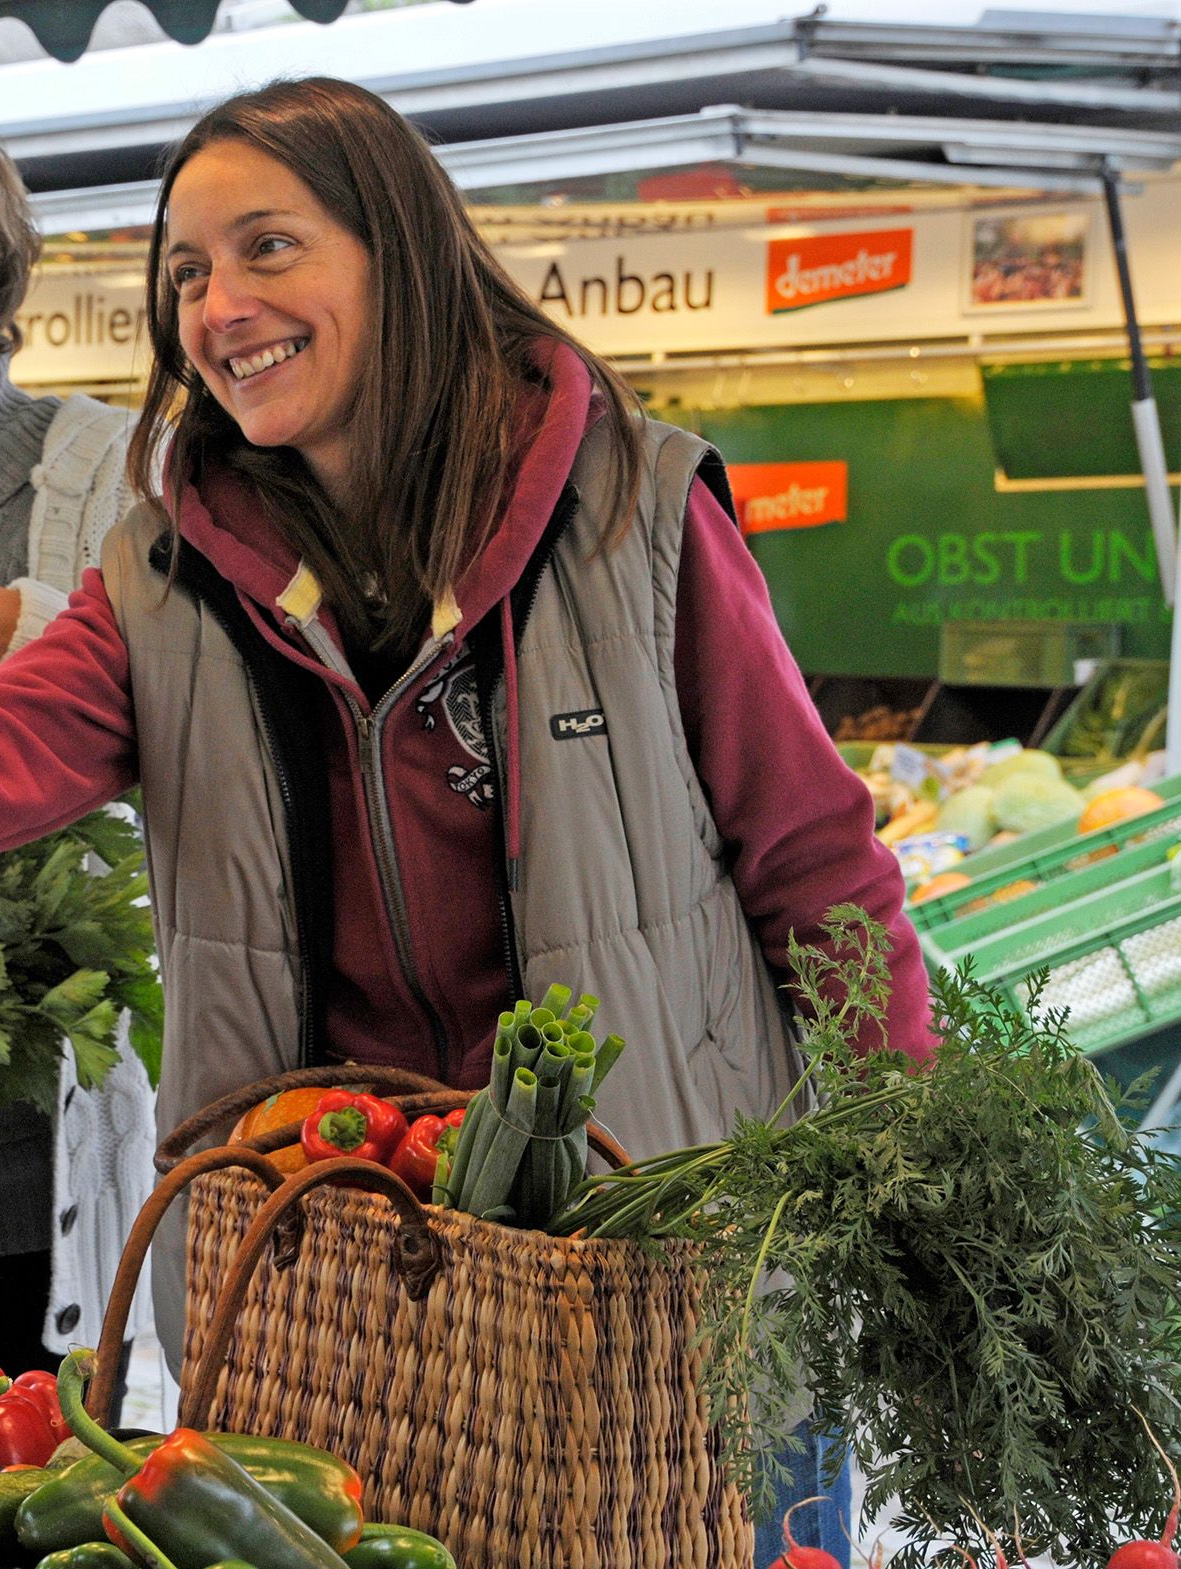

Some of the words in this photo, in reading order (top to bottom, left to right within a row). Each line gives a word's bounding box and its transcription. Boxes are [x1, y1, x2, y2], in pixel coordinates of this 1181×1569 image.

[538, 254, 714, 317] Anbau
[775, 248, 897, 300] demeter
[745, 481, 829, 523] meter
[885, 531, 1045, 588] OBST
[557, 714, 605, 735] H2O
